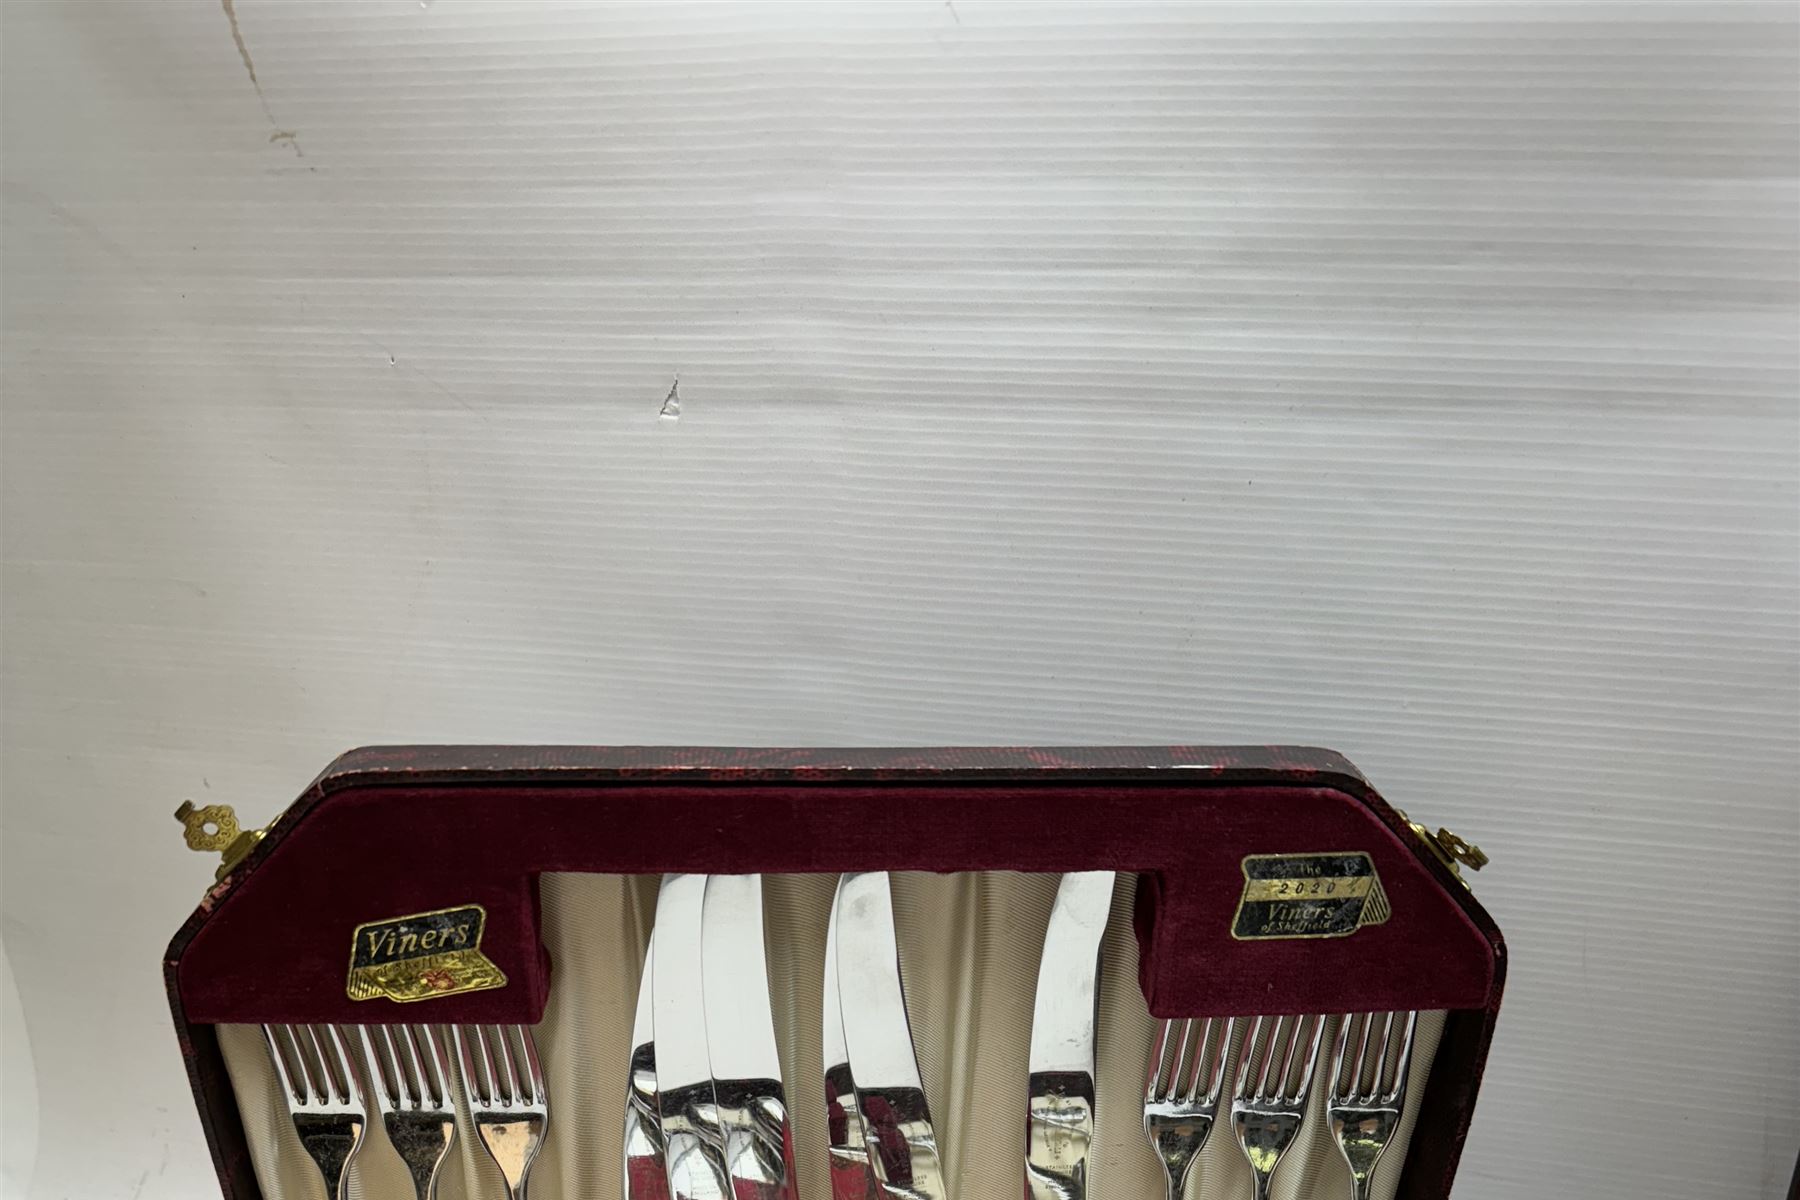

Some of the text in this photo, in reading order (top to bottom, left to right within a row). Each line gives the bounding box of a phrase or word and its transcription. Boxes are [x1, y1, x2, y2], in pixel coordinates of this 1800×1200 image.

[1279, 882, 1336, 895] 2020
[1268, 903, 1335, 921] Viners
[1261, 920, 1330, 934] of Sheffield
[366, 923, 470, 959] Viners
